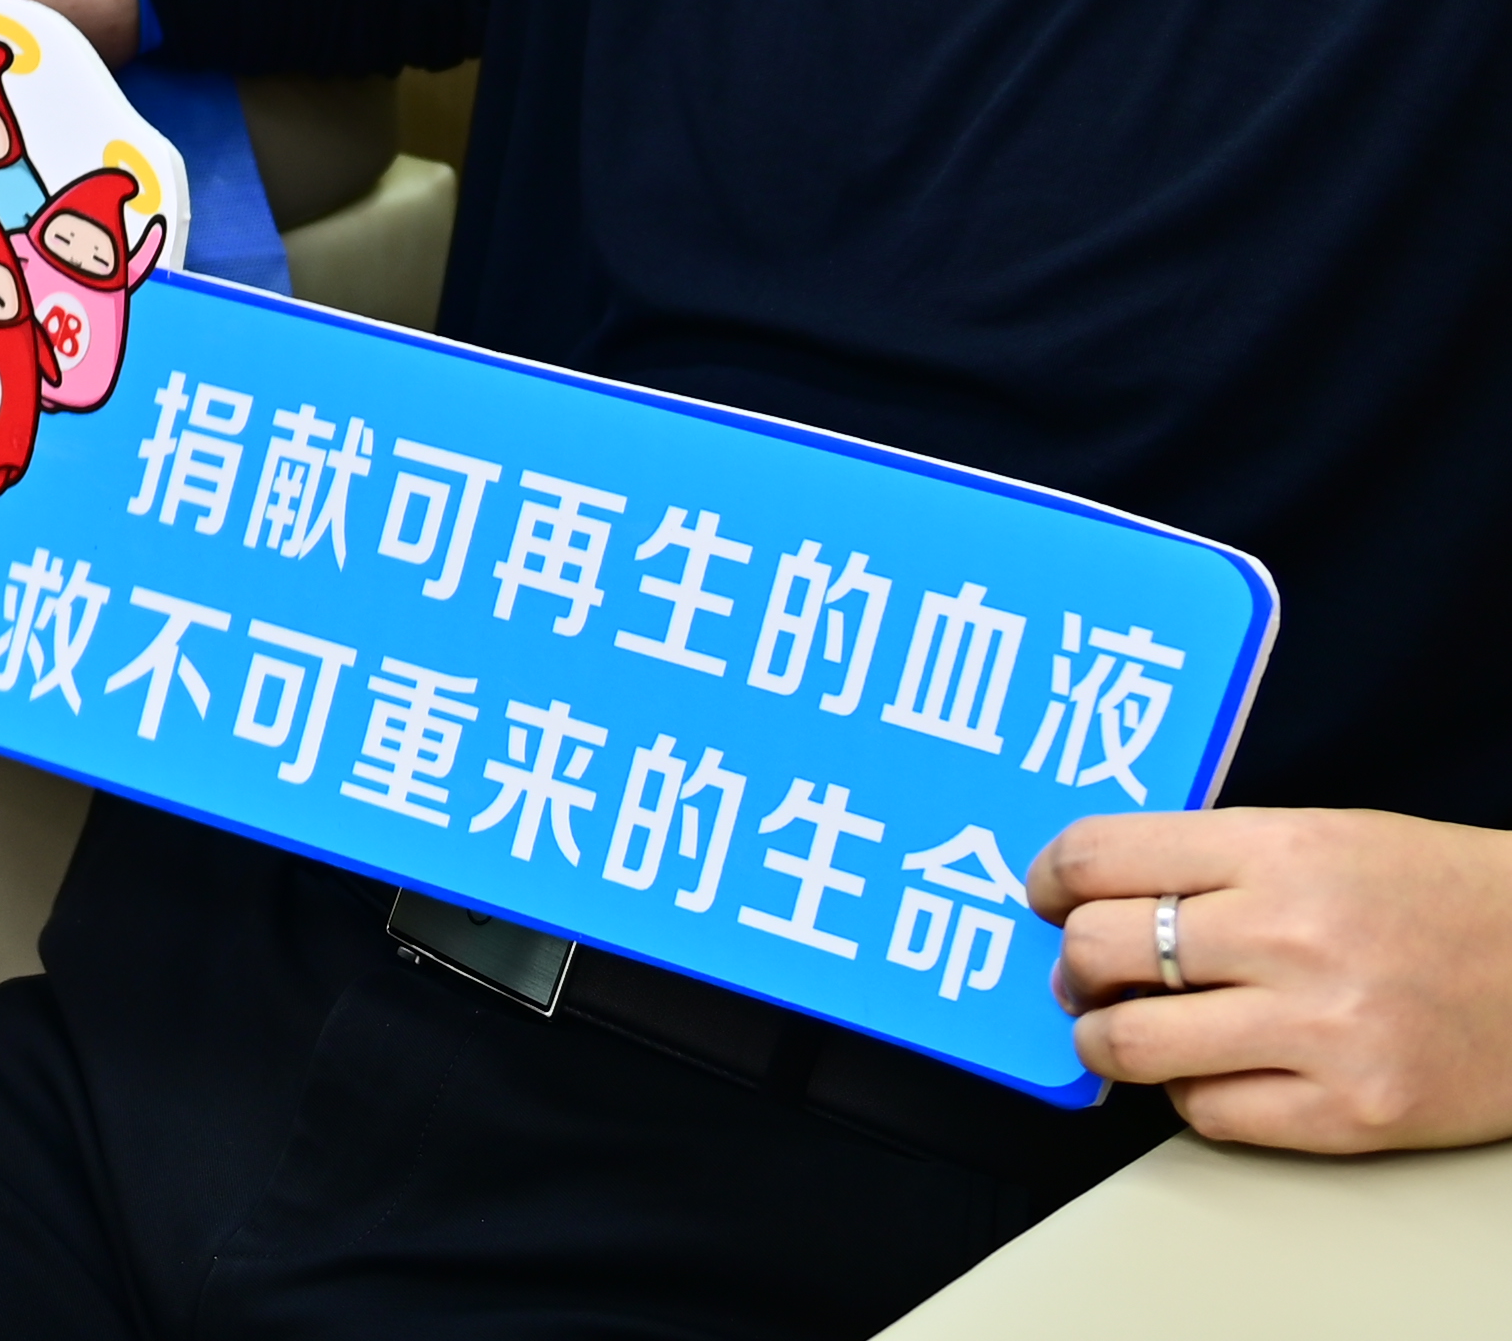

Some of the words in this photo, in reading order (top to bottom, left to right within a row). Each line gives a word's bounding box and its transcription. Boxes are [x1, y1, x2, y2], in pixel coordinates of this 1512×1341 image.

[42, 304, 82, 358] AB
[128, 372, 1186, 806] 捐献可再生的血液
